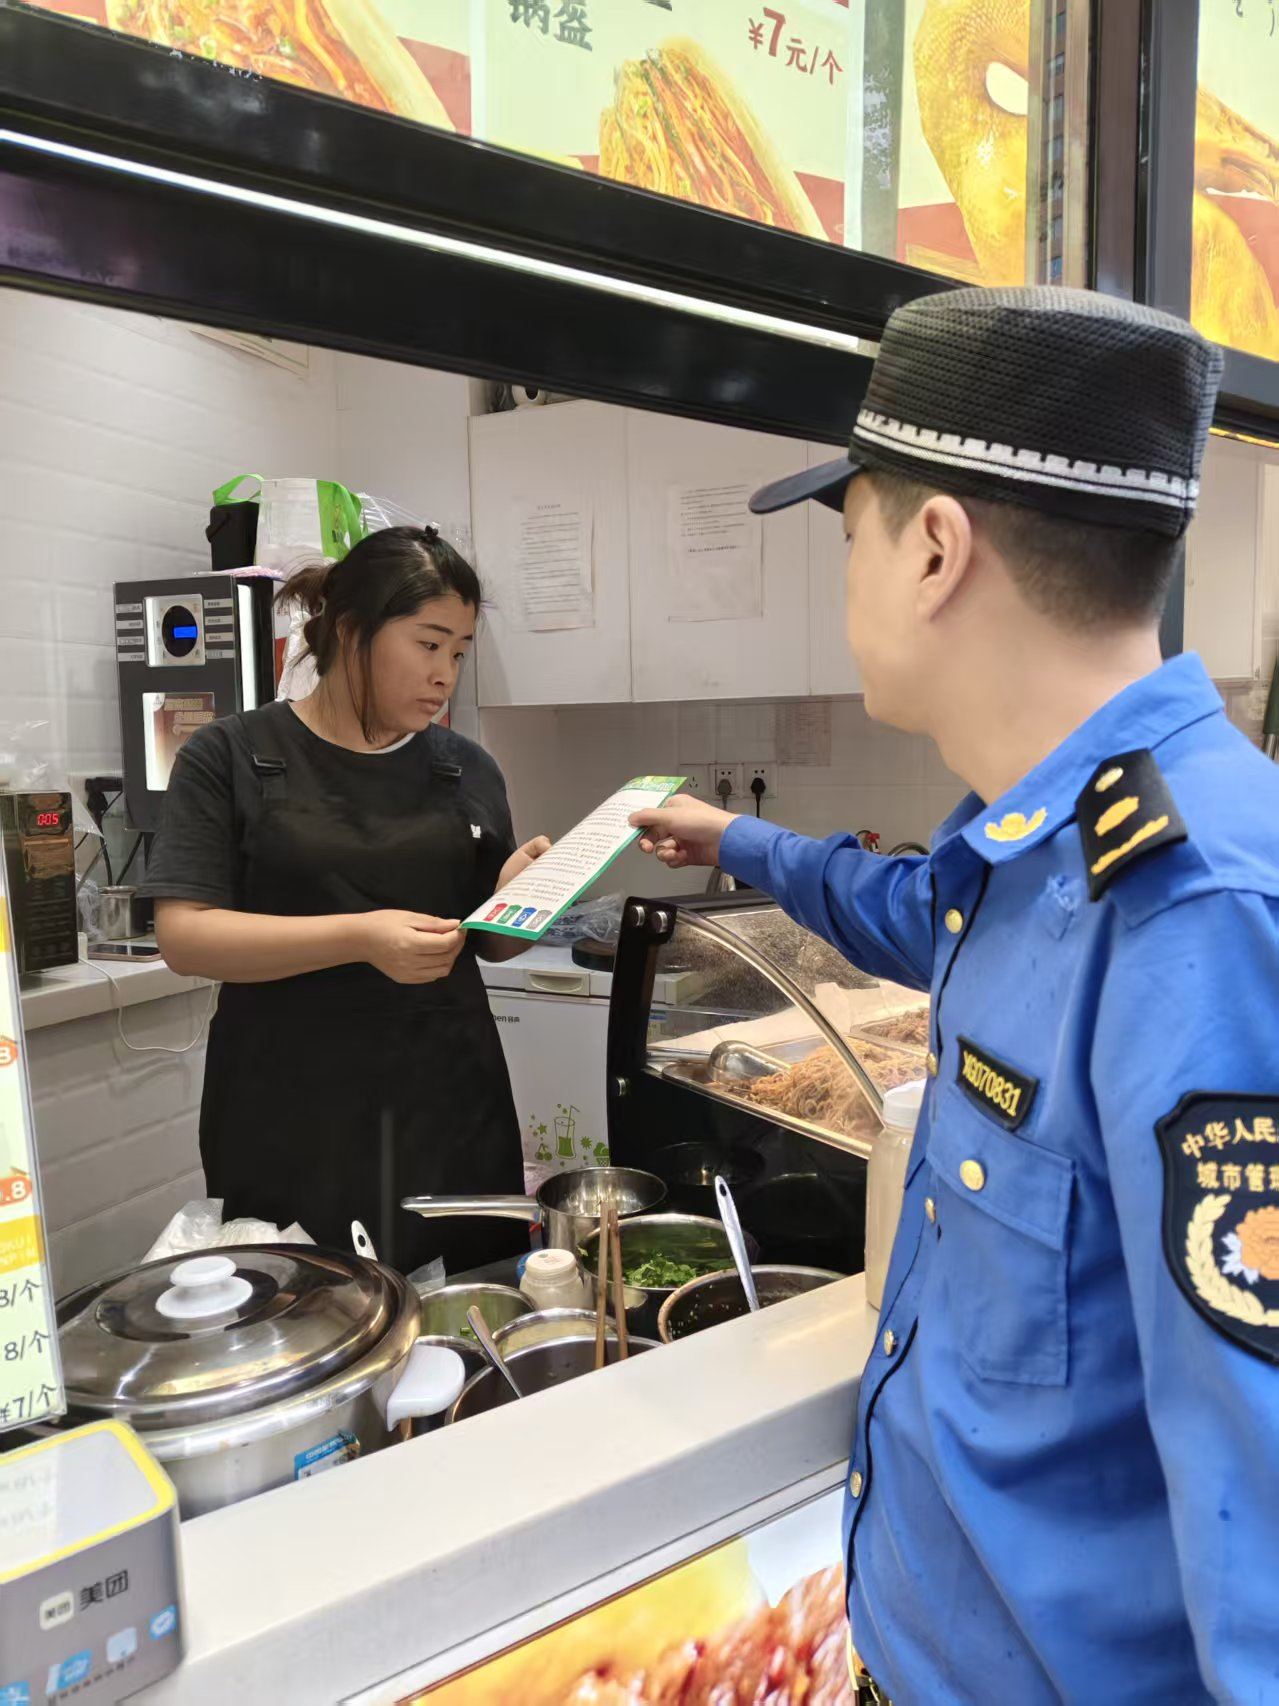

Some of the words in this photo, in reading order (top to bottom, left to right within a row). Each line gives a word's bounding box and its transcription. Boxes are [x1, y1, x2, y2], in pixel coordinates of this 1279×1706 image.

[748, 7, 844, 85] ¥7元/个
[1182, 1116, 1277, 1159] 中华人民
[79, 1569, 129, 1612] 美团
